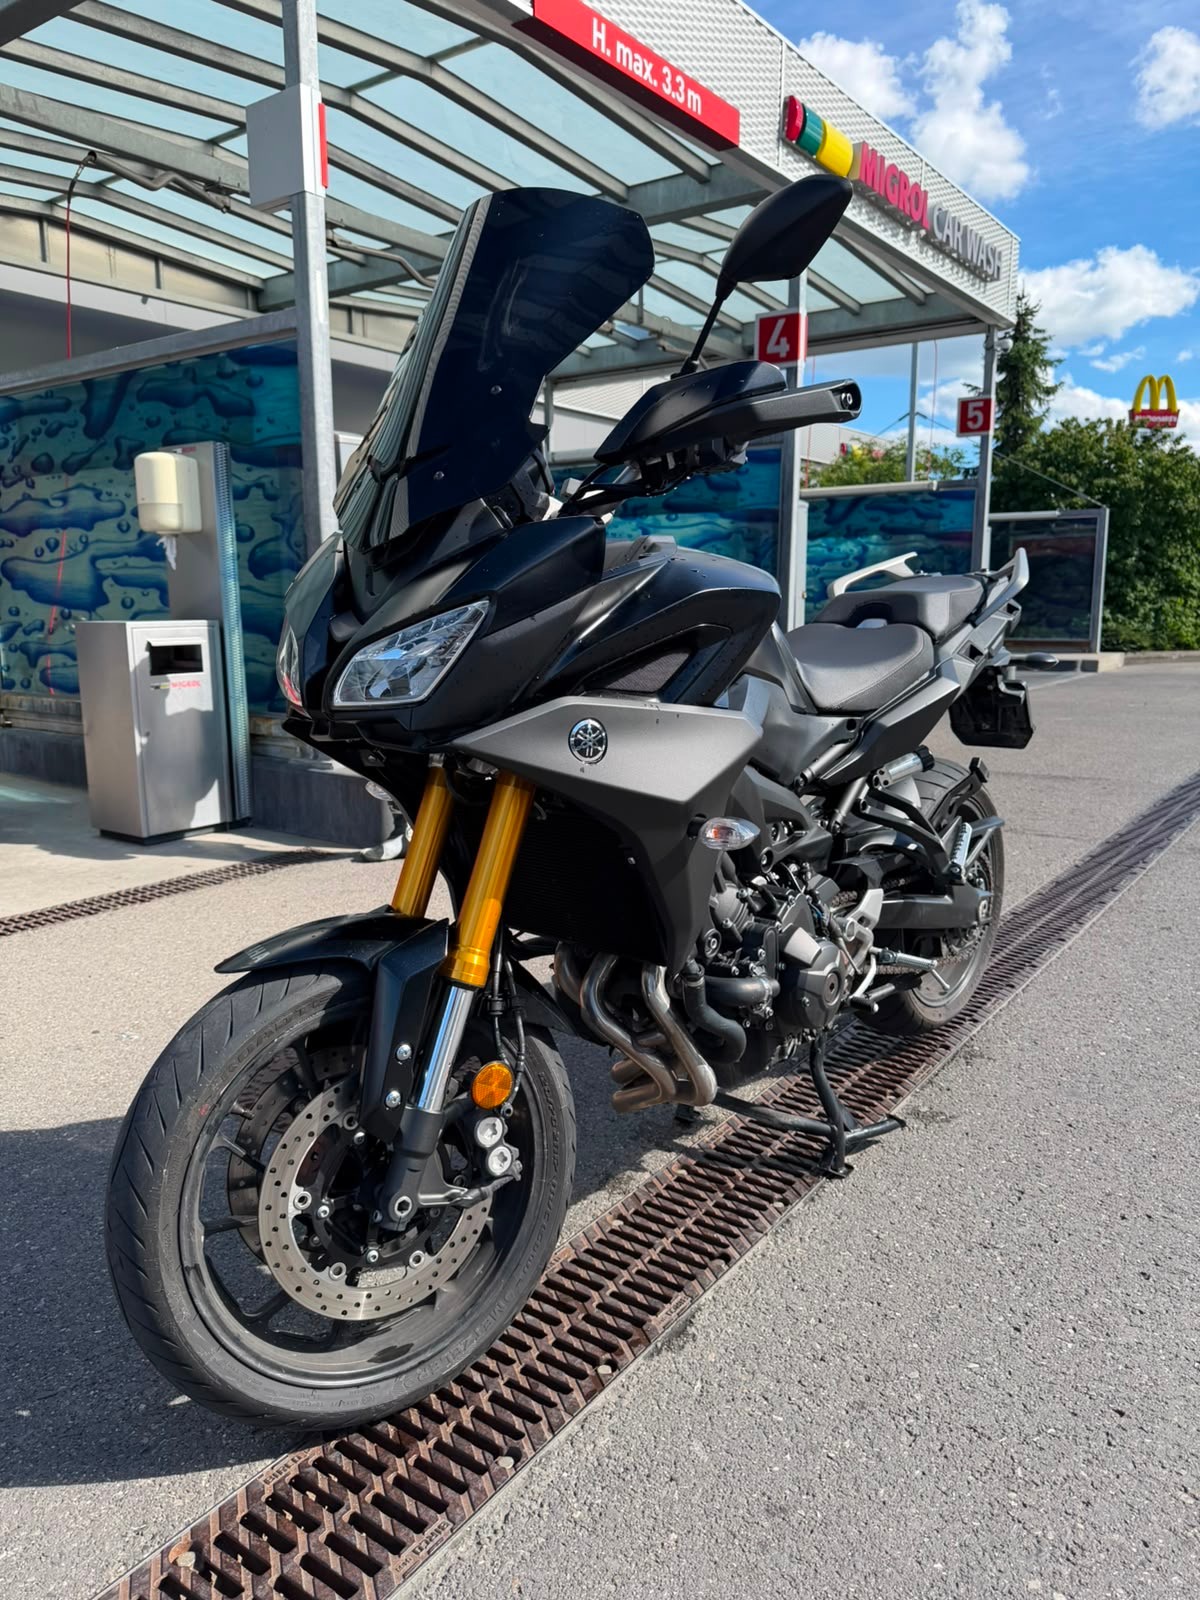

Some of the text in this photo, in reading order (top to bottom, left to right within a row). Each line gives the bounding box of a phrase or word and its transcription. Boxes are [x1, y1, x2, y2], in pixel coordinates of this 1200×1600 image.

[592, 17, 702, 115] H. max. 3.3 m
[859, 140, 1001, 279] MIGROL CAR WASH
[766, 318, 790, 358] 4
[966, 401, 984, 430] 5
